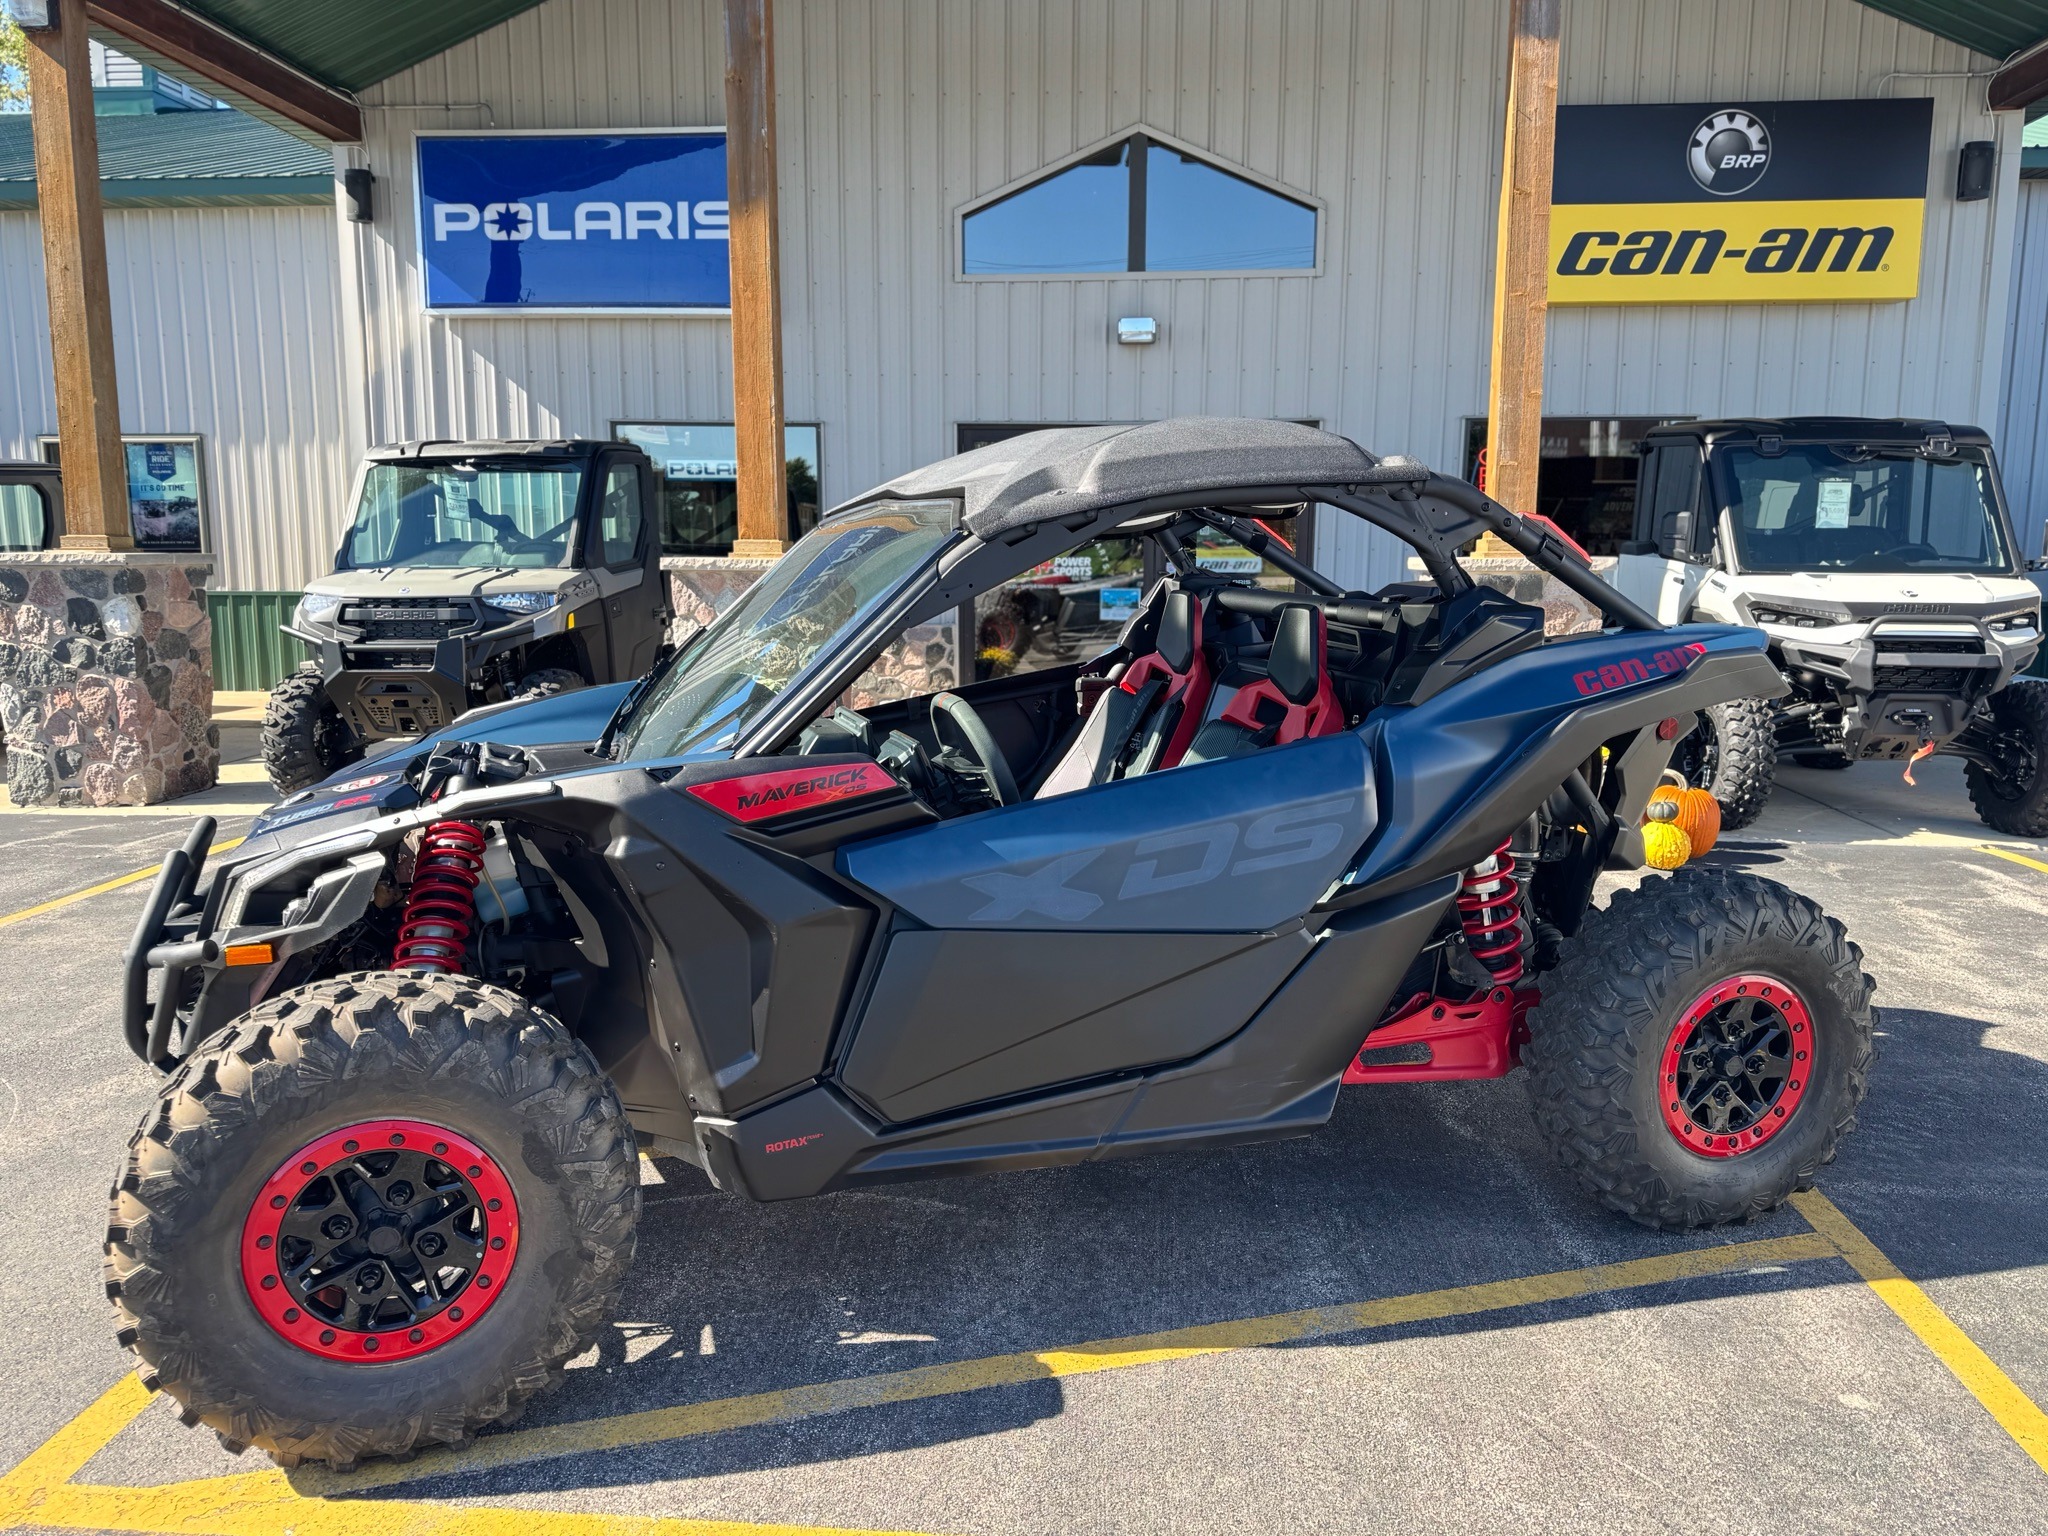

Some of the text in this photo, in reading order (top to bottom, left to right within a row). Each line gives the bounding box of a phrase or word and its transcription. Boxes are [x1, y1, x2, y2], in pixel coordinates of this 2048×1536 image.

[1720, 154, 1766, 169] BRP
[433, 201, 730, 242] POLARIS
[1556, 226, 1895, 276] can-am
[151, 455, 170, 463] RIDE
[670, 463, 737, 476] POLA
[1054, 557, 1091, 567] POWER
[1200, 560, 1258, 570] can-am
[1053, 567, 1092, 576] SPORTS
[572, 579, 592, 592] XP
[374, 610, 437, 620] POLARIS
[1884, 604, 1951, 615] can-am
[737, 766, 869, 811] MAVERICK
[826, 783, 868, 801] XDS
[271, 793, 373, 826] TURBO RR
[959, 797, 1356, 922] XDS
[765, 1136, 808, 1154] ROTAX
